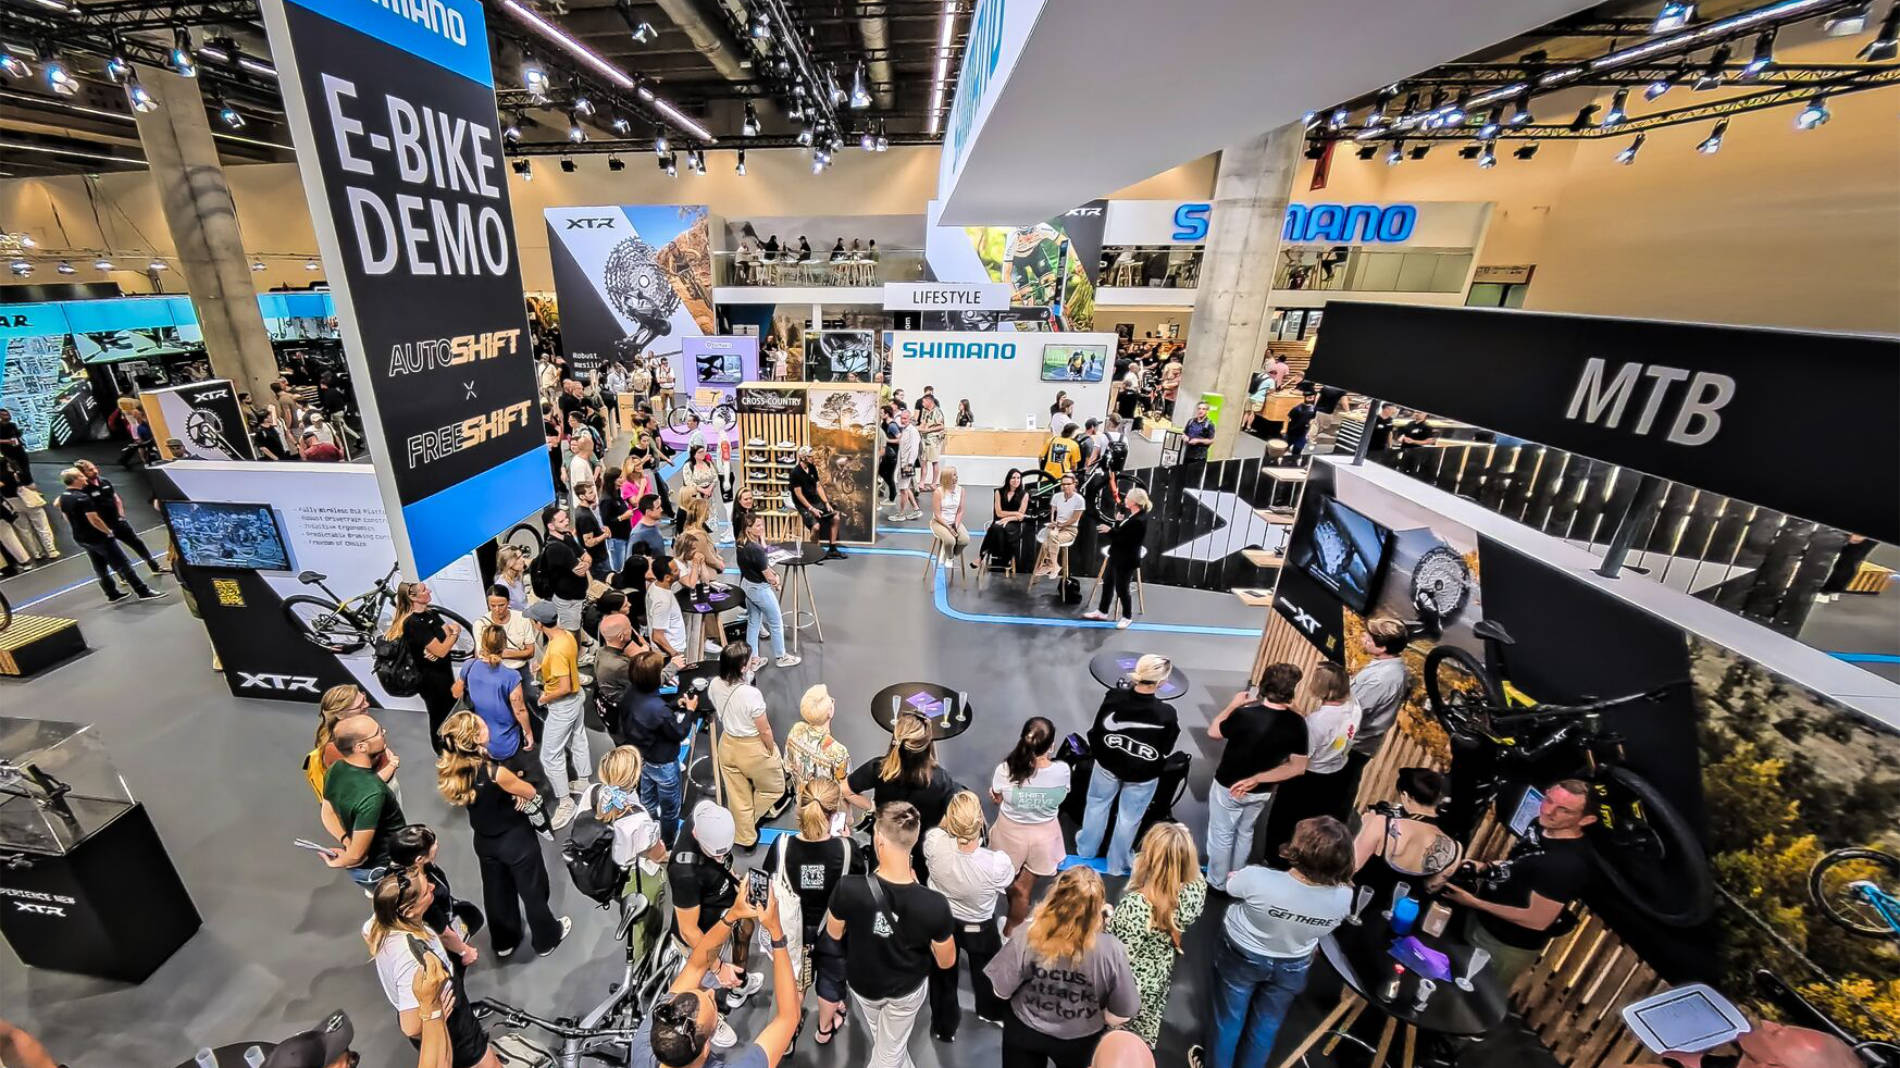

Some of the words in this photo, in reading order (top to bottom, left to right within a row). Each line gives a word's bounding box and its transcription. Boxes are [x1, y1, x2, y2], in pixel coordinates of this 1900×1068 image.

[321, 72, 500, 198] E-BIKE
[1064, 207, 1102, 216] XTR
[346, 186, 509, 276] DEMO
[566, 217, 615, 229] XTR
[912, 290, 981, 304] LIFESTYLE
[389, 328, 521, 377] AUTOSHIFT
[902, 341, 1017, 360] SHIMANO
[193, 389, 230, 403] XTR
[1565, 356, 1736, 447] MTB
[407, 400, 532, 469] FREESHIFT
[237, 671, 321, 693] XTR
[1108, 736, 1153, 759] AIR
[13, 901, 67, 917] XTR
[1295, 914, 1334, 927] THERE
